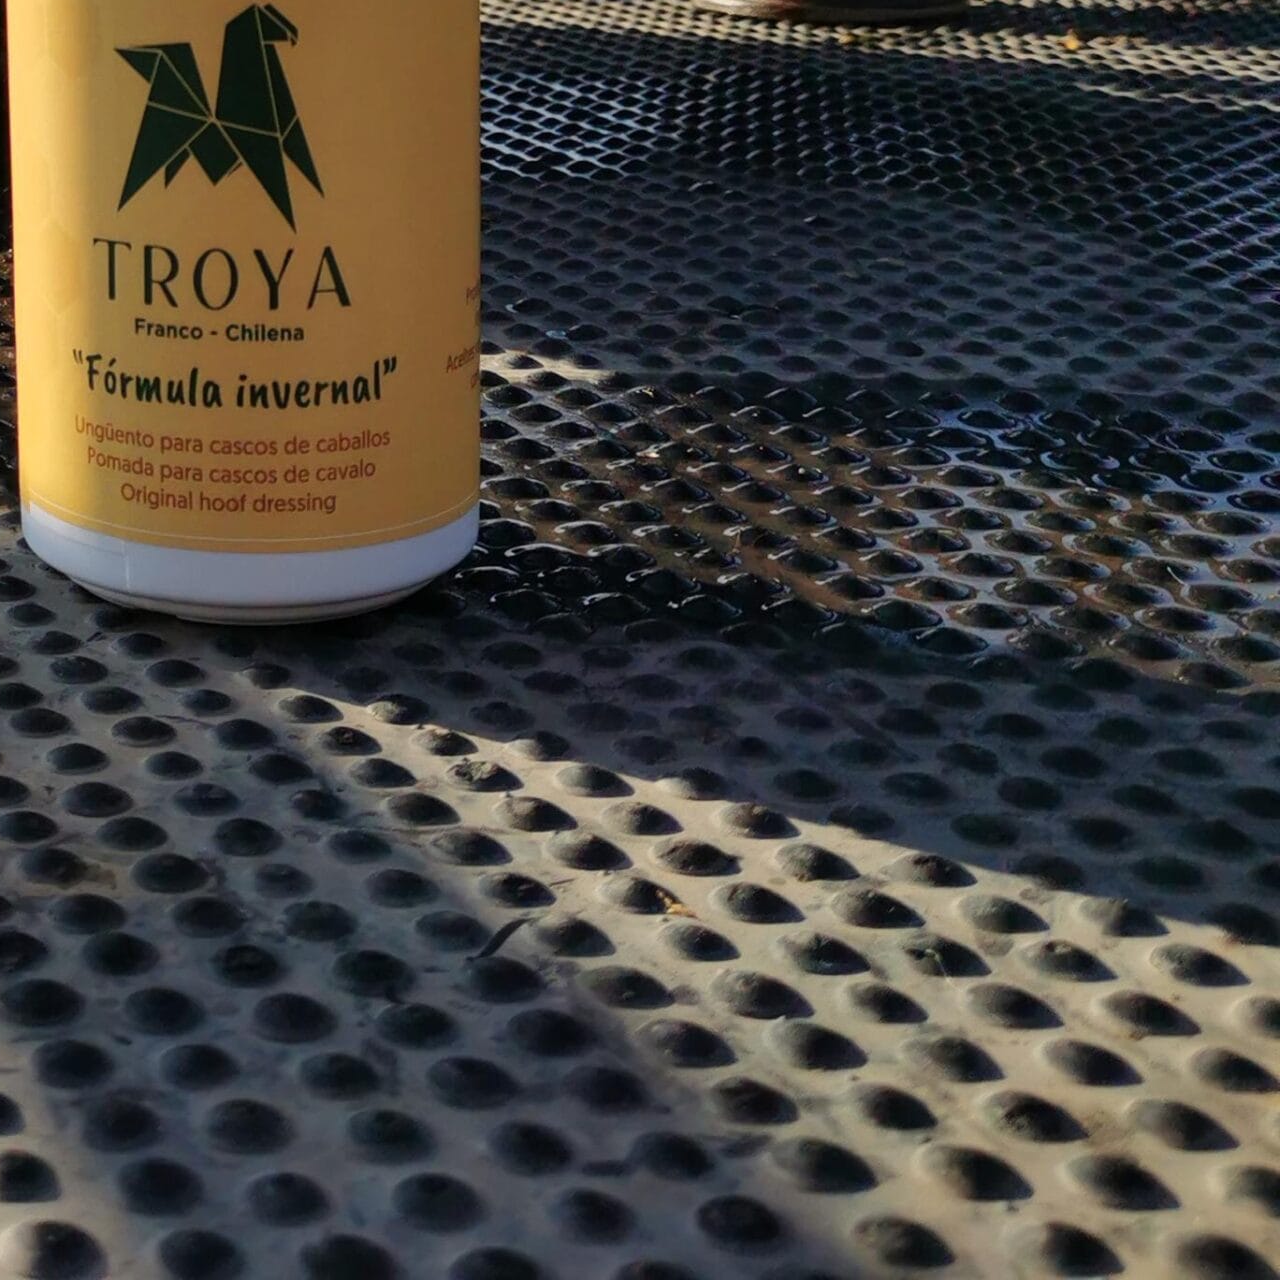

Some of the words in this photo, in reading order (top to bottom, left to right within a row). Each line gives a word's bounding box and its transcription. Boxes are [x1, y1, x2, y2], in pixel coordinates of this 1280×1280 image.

[92, 237, 352, 312] TROYA
[133, 318, 204, 341] Franco
[225, 323, 305, 343] Chilena
[74, 414, 154, 449] Ungüento
[160, 435, 203, 455] para
[209, 438, 279, 456] cascos
[283, 435, 310, 455] de
[316, 429, 391, 454] caballos
[87, 445, 154, 478] Pomada
[160, 463, 203, 483] para
[208, 468, 278, 485] cascos
[283, 464, 310, 484] de
[315, 457, 376, 483] cavalo
[120, 482, 193, 510] Original
[200, 491, 247, 513] hoof
[252, 492, 337, 515] dressing
